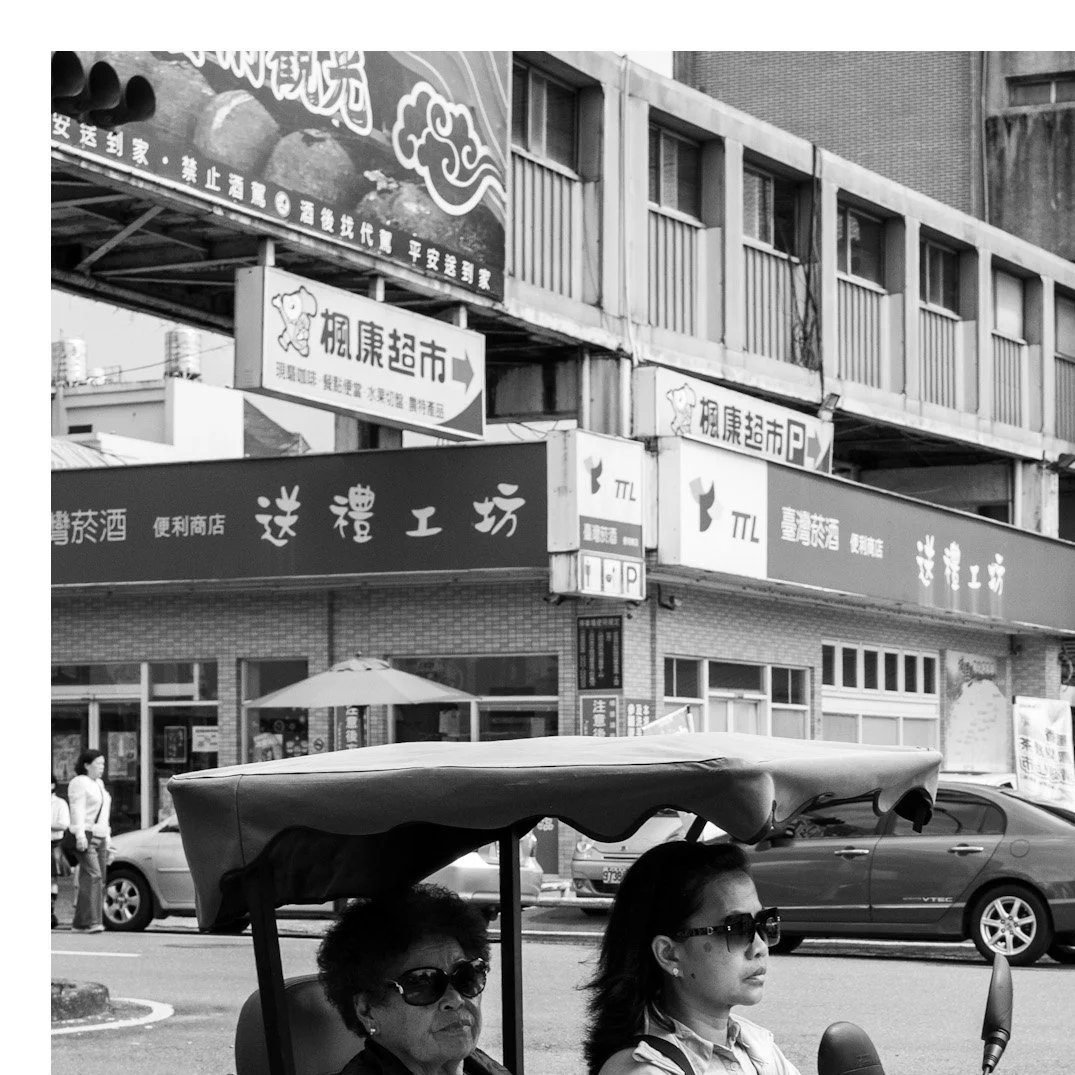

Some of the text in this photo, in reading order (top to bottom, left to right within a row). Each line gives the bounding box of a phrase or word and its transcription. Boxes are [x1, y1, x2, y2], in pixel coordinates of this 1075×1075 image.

[409, 239, 492, 291] 平安送到家
[320, 308, 447, 384] 楓康超市
[700, 397, 784, 456] 楓康超市
[153, 513, 226, 539] 便利商店
[255, 484, 526, 547] 送禮工坊
[615, 479, 636, 502] TTL
[732, 510, 760, 544] TTL
[781, 506, 1006, 596] 臺灣菸酒 便利商店 送禮工坊
